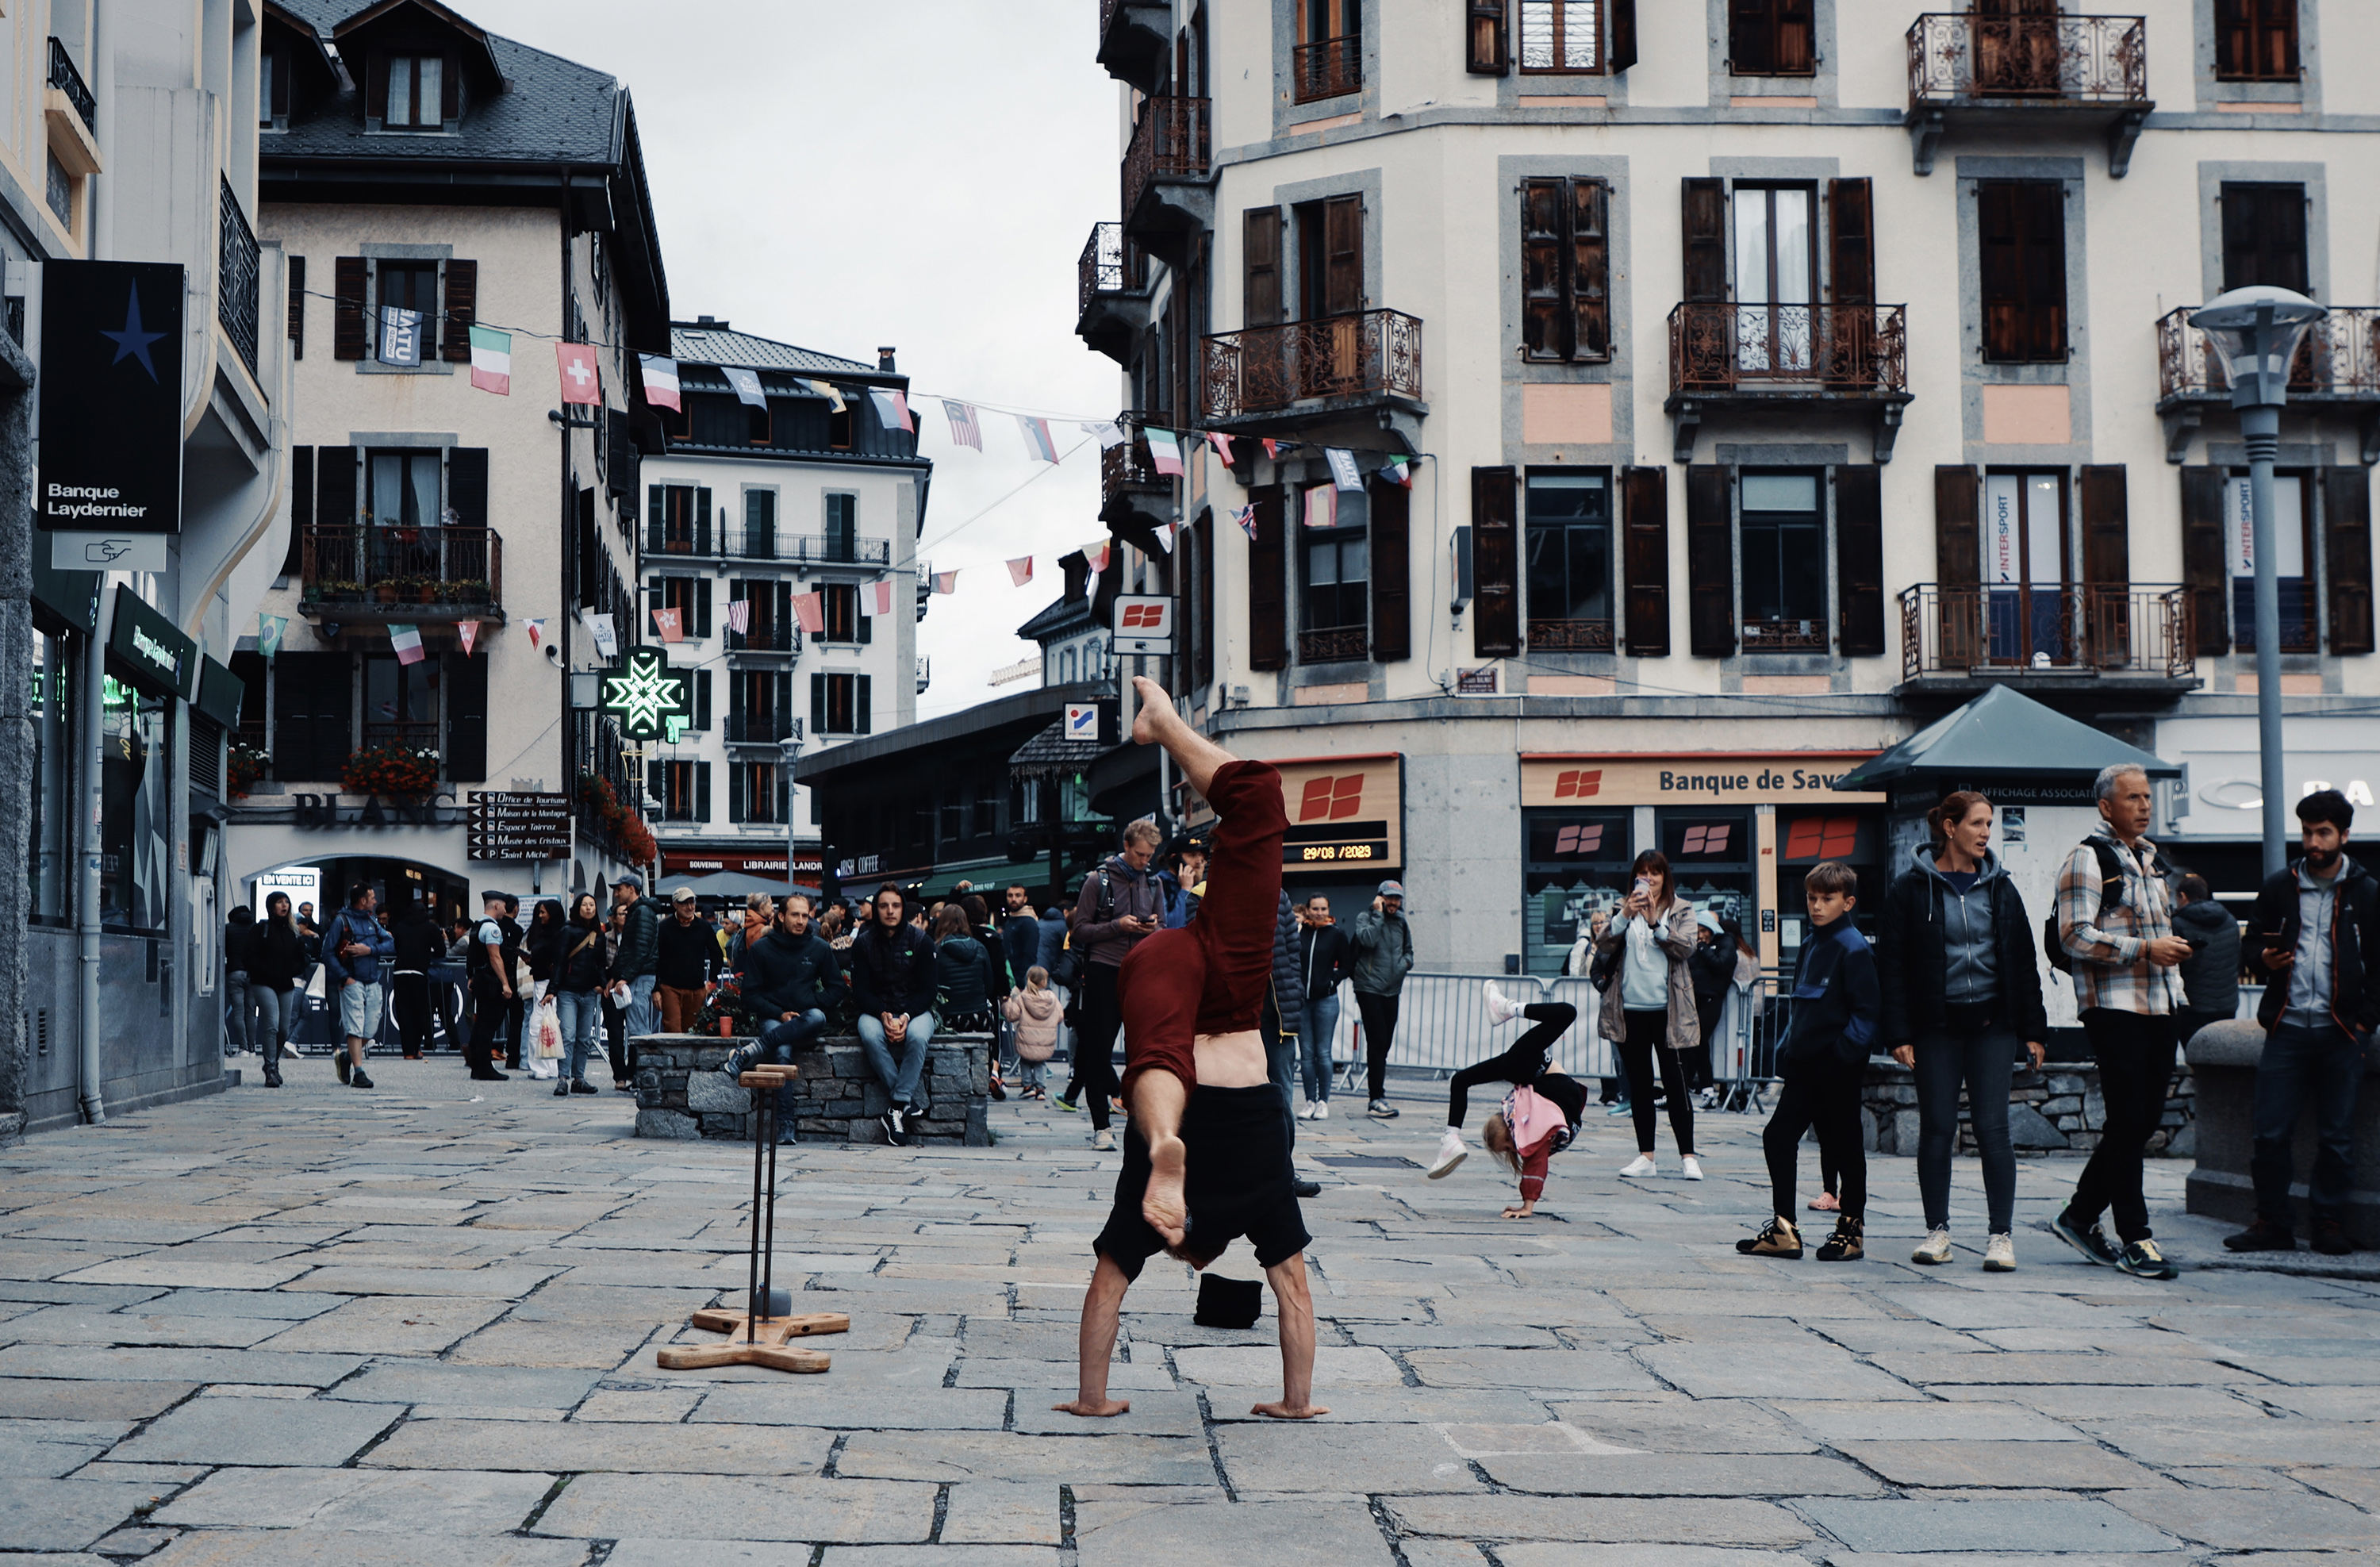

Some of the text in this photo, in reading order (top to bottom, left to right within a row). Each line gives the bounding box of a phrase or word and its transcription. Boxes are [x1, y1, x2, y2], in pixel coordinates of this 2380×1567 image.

[48, 483, 120, 501] Banque
[48, 501, 148, 519] Laydernier
[2240, 482, 2251, 558] INTERSPORT
[1998, 495, 2009, 571] INTERSPORT
[1660, 771, 1749, 795] Banque
[1756, 769, 1784, 789] de
[1980, 787, 2036, 797] AFFICHAGE
[497, 793, 521, 804] Office
[292, 793, 456, 825] BLANC
[497, 807, 520, 818] Maison
[539, 810, 567, 819] Montagne
[497, 821, 526, 832] Espace
[497, 835, 523, 845] Musée
[501, 849, 523, 859] Saint
[743, 861, 787, 870] LIBRAIRIE
[858, 855, 879, 874] COFFEE
[263, 874, 313, 885] EN VENTE ICI
